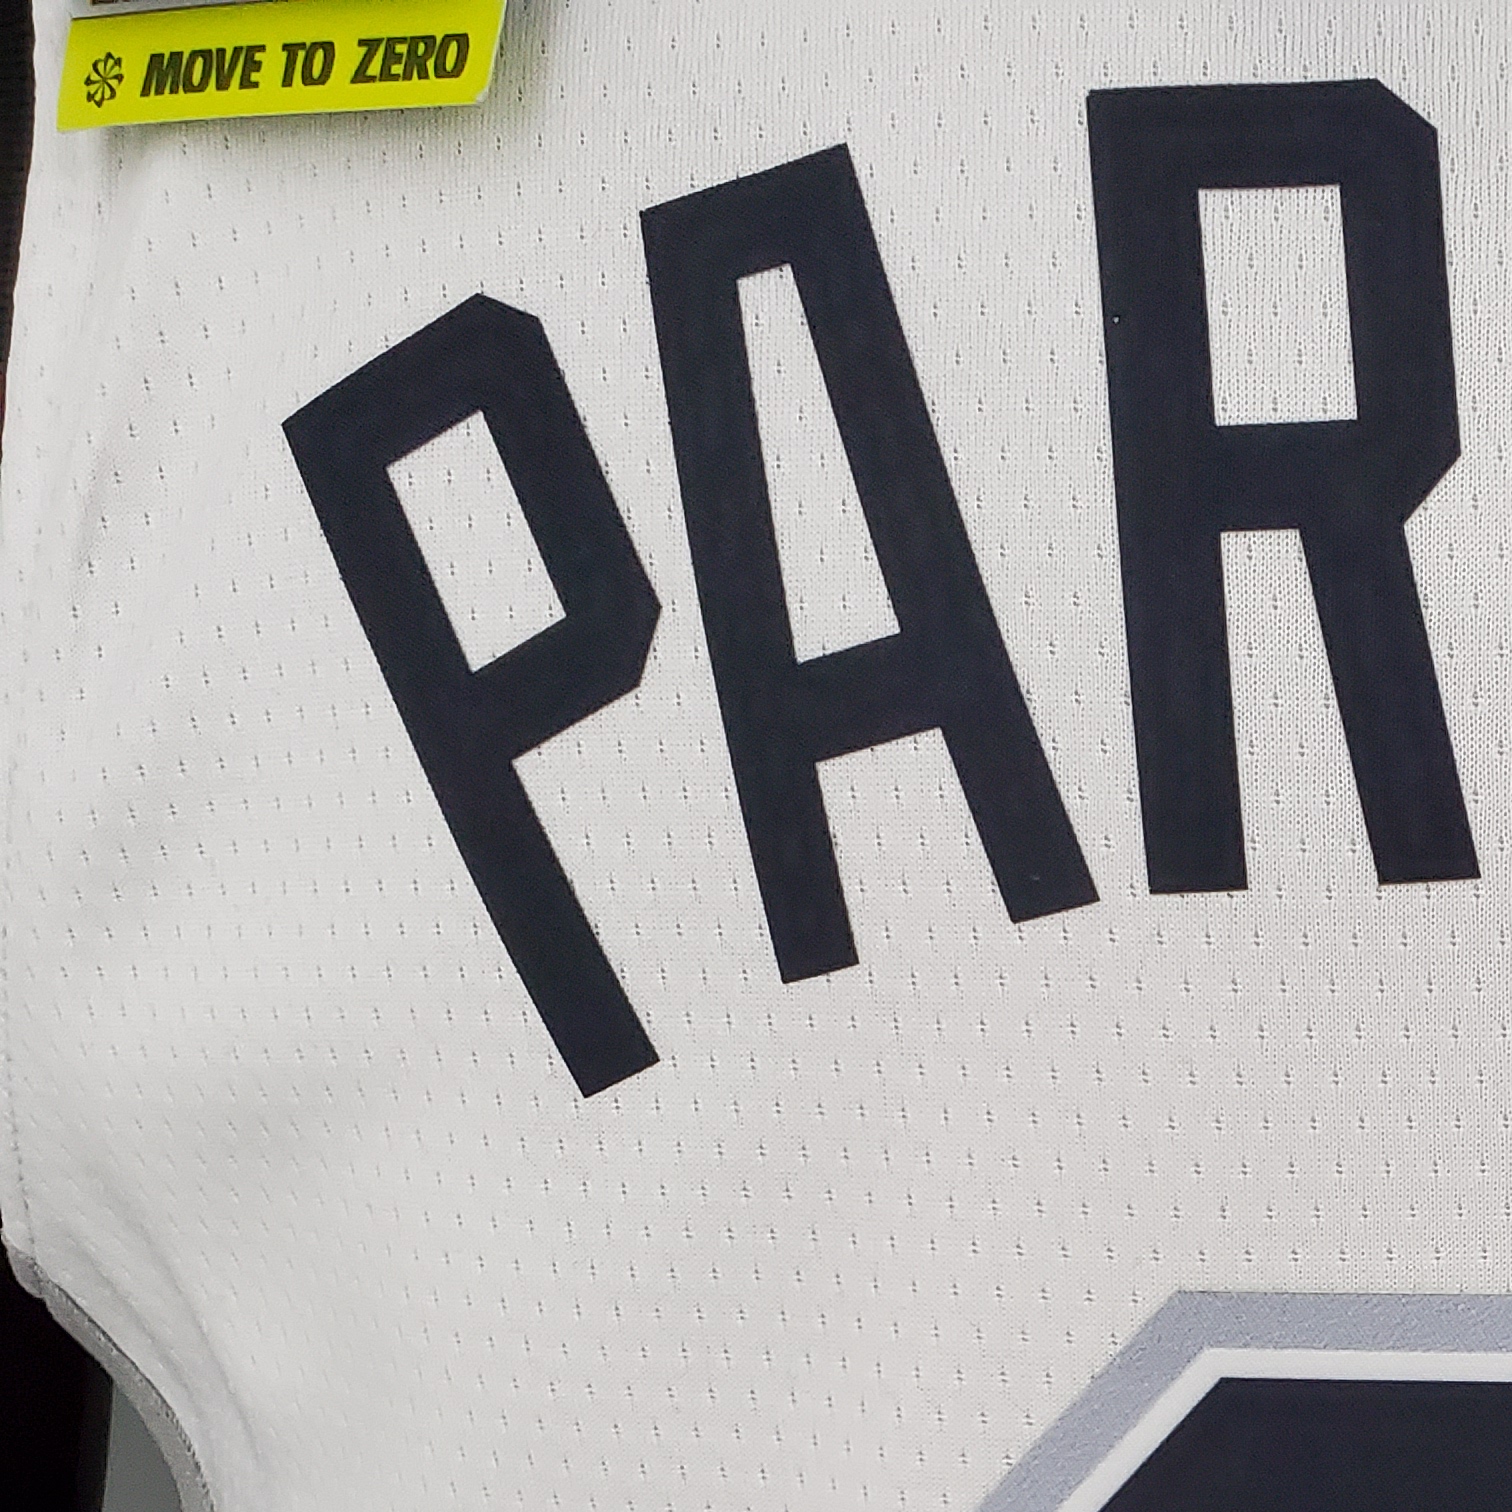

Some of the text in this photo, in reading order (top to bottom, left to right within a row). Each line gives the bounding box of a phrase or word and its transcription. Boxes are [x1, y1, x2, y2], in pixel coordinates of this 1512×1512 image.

[139, 32, 470, 98] MOVE TO ZERO
